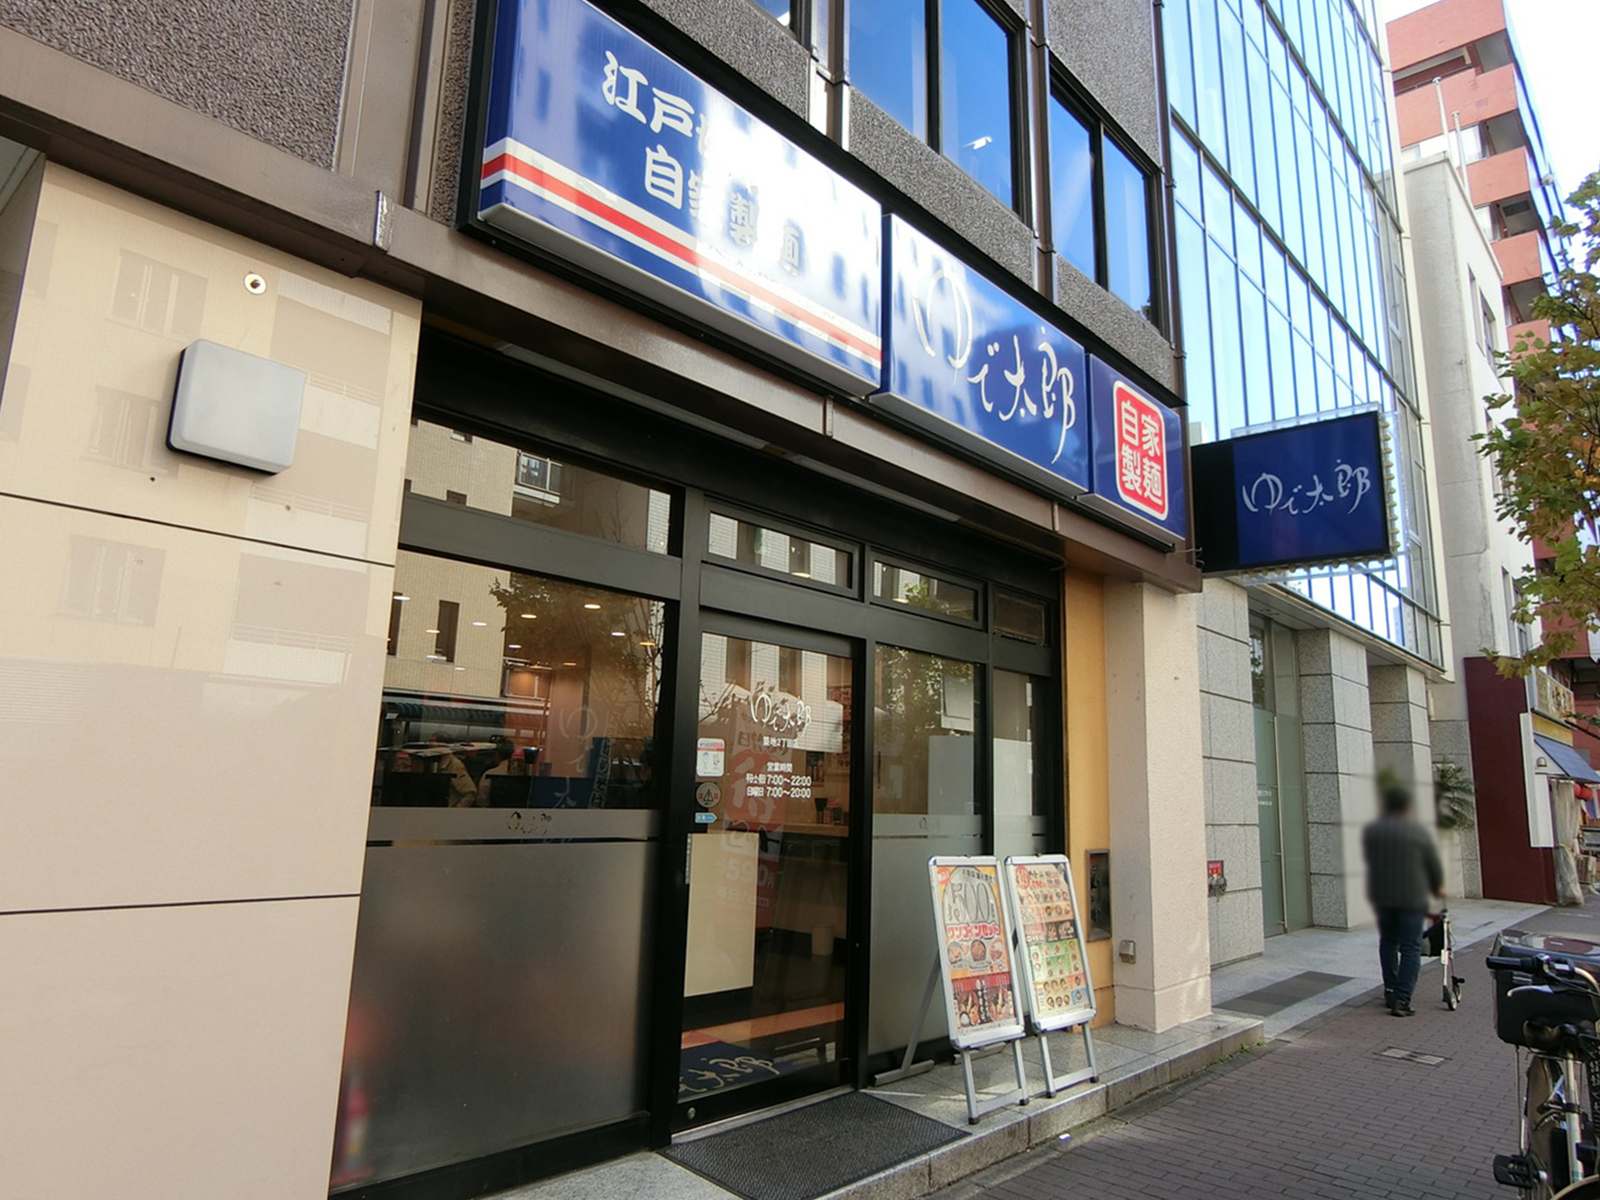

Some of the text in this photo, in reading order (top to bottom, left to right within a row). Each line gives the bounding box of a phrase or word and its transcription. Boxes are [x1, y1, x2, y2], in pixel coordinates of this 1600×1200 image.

[912, 268, 1077, 464] ゆで太郎
[1120, 399, 1160, 458] 自家
[1121, 442, 1163, 506] 製麺
[1242, 458, 1371, 516] ゆで太郎
[750, 691, 812, 740] ゆで太郎
